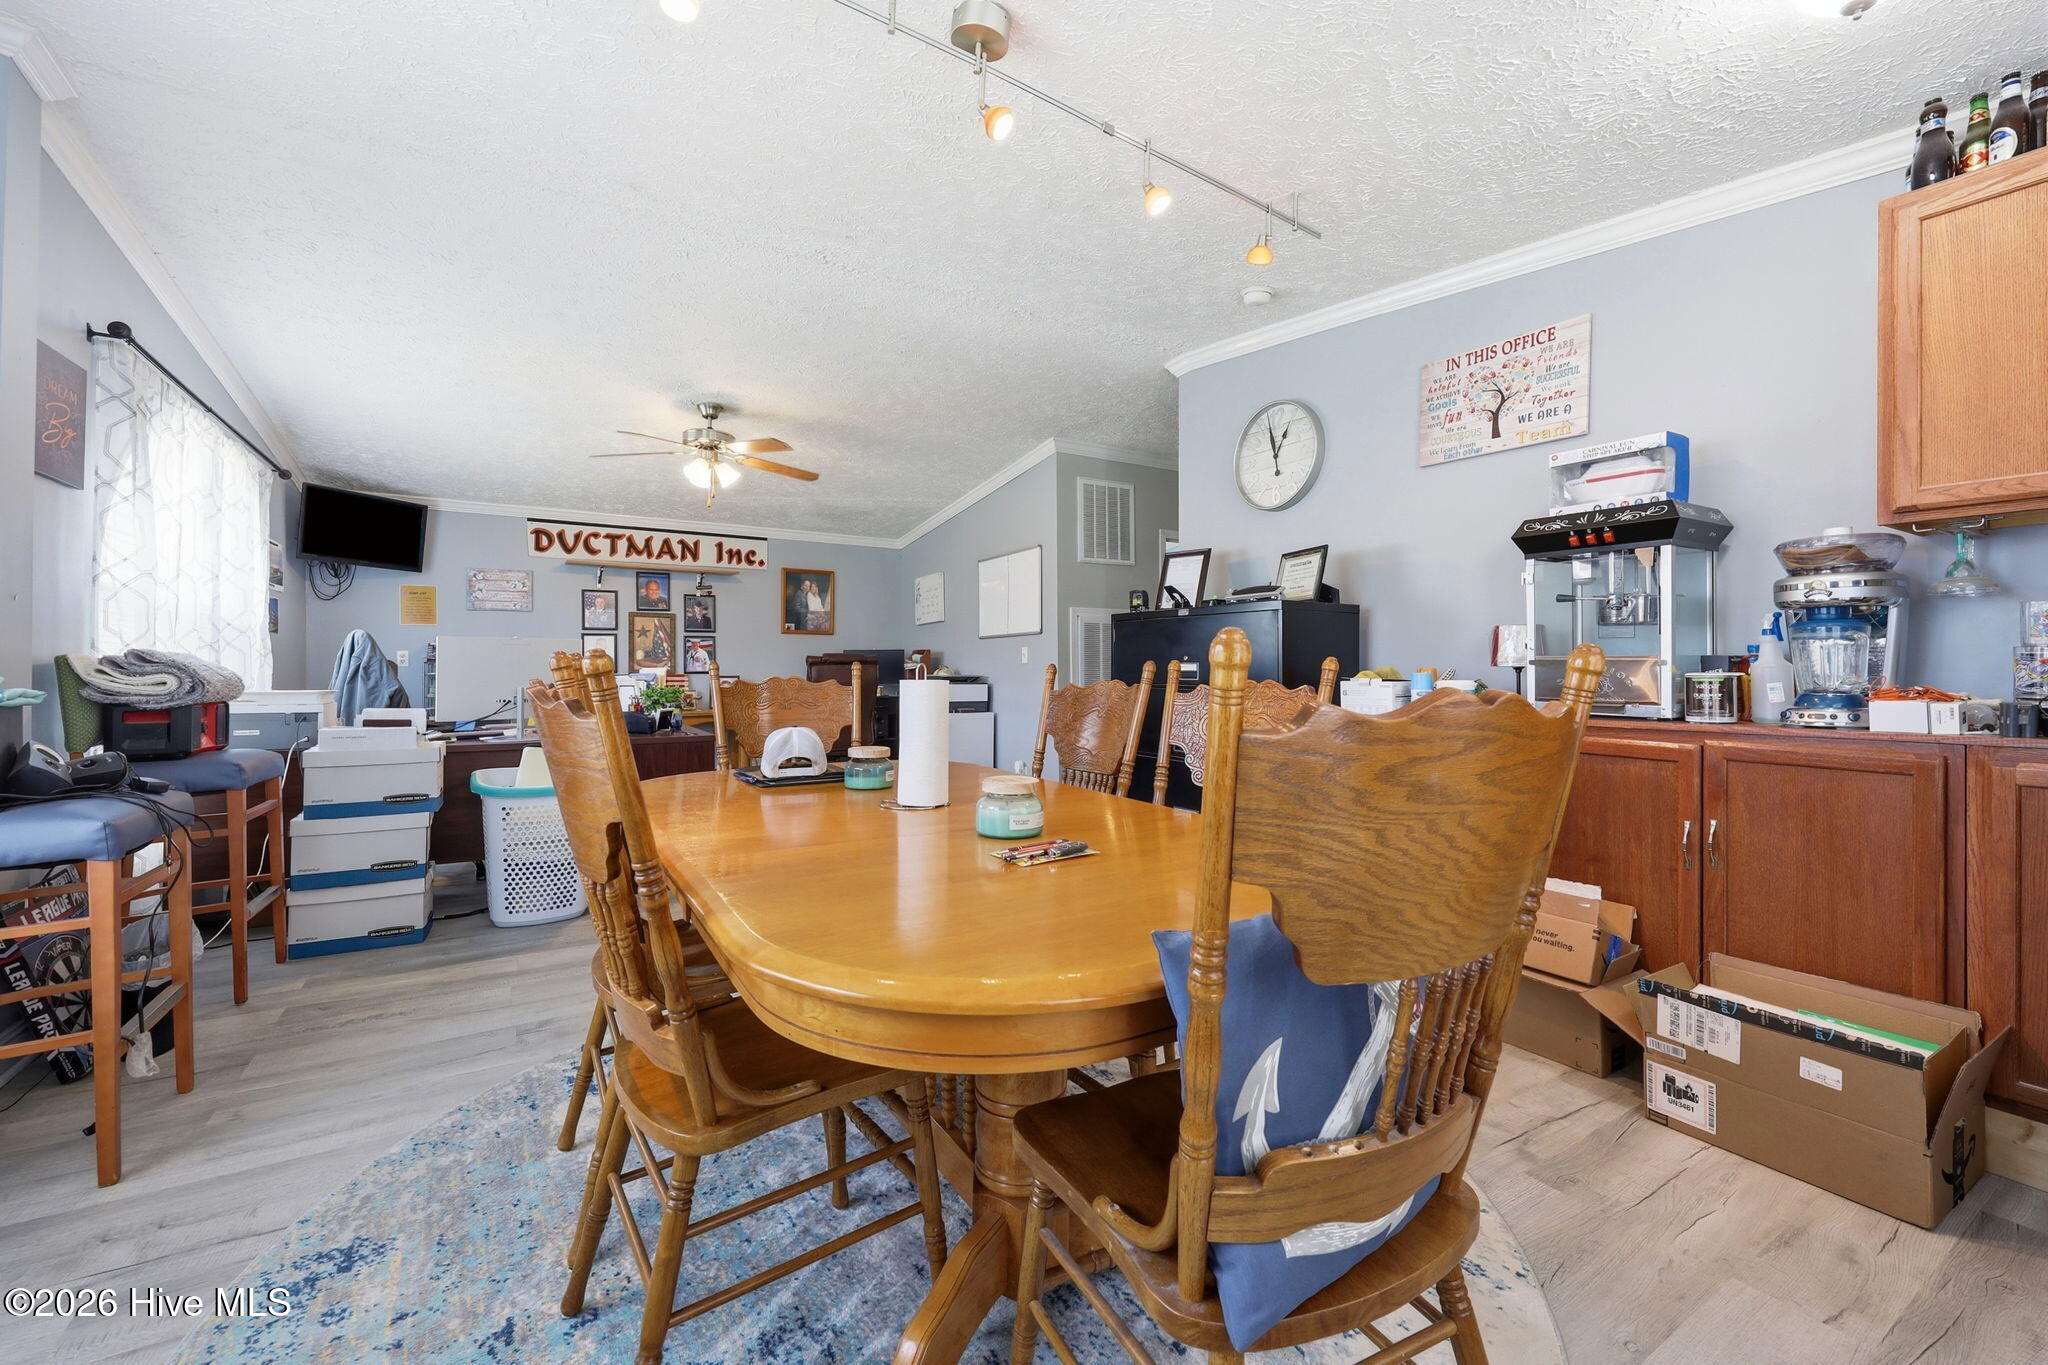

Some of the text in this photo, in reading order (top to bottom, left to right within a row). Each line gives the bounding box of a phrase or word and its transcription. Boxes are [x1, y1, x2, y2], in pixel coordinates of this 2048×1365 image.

[1445, 326, 1556, 372] IN THIS OFFICE
[1540, 338, 1575, 354] WE ARE
[1536, 346, 1578, 365] Friends
[1535, 365, 1580, 385] SUCCESSFUL
[1545, 363, 1557, 373] We
[1427, 378, 1462, 395] helpful
[1433, 373, 1457, 385] WE ARE
[43, 375, 79, 406] DREAM
[1436, 390, 1461, 401] ACHIEVE
[1532, 388, 1576, 408] Together
[1427, 398, 1458, 412] Goals
[1518, 403, 1572, 424] WE ARE A
[1441, 408, 1463, 430] fun
[1515, 423, 1572, 444] Team
[715, 541, 766, 567] Inc.
[1535, 928, 1558, 939] never
[1532, 935, 1576, 952] ou waiting.
[1667, 1097, 1695, 1113] UN3481
